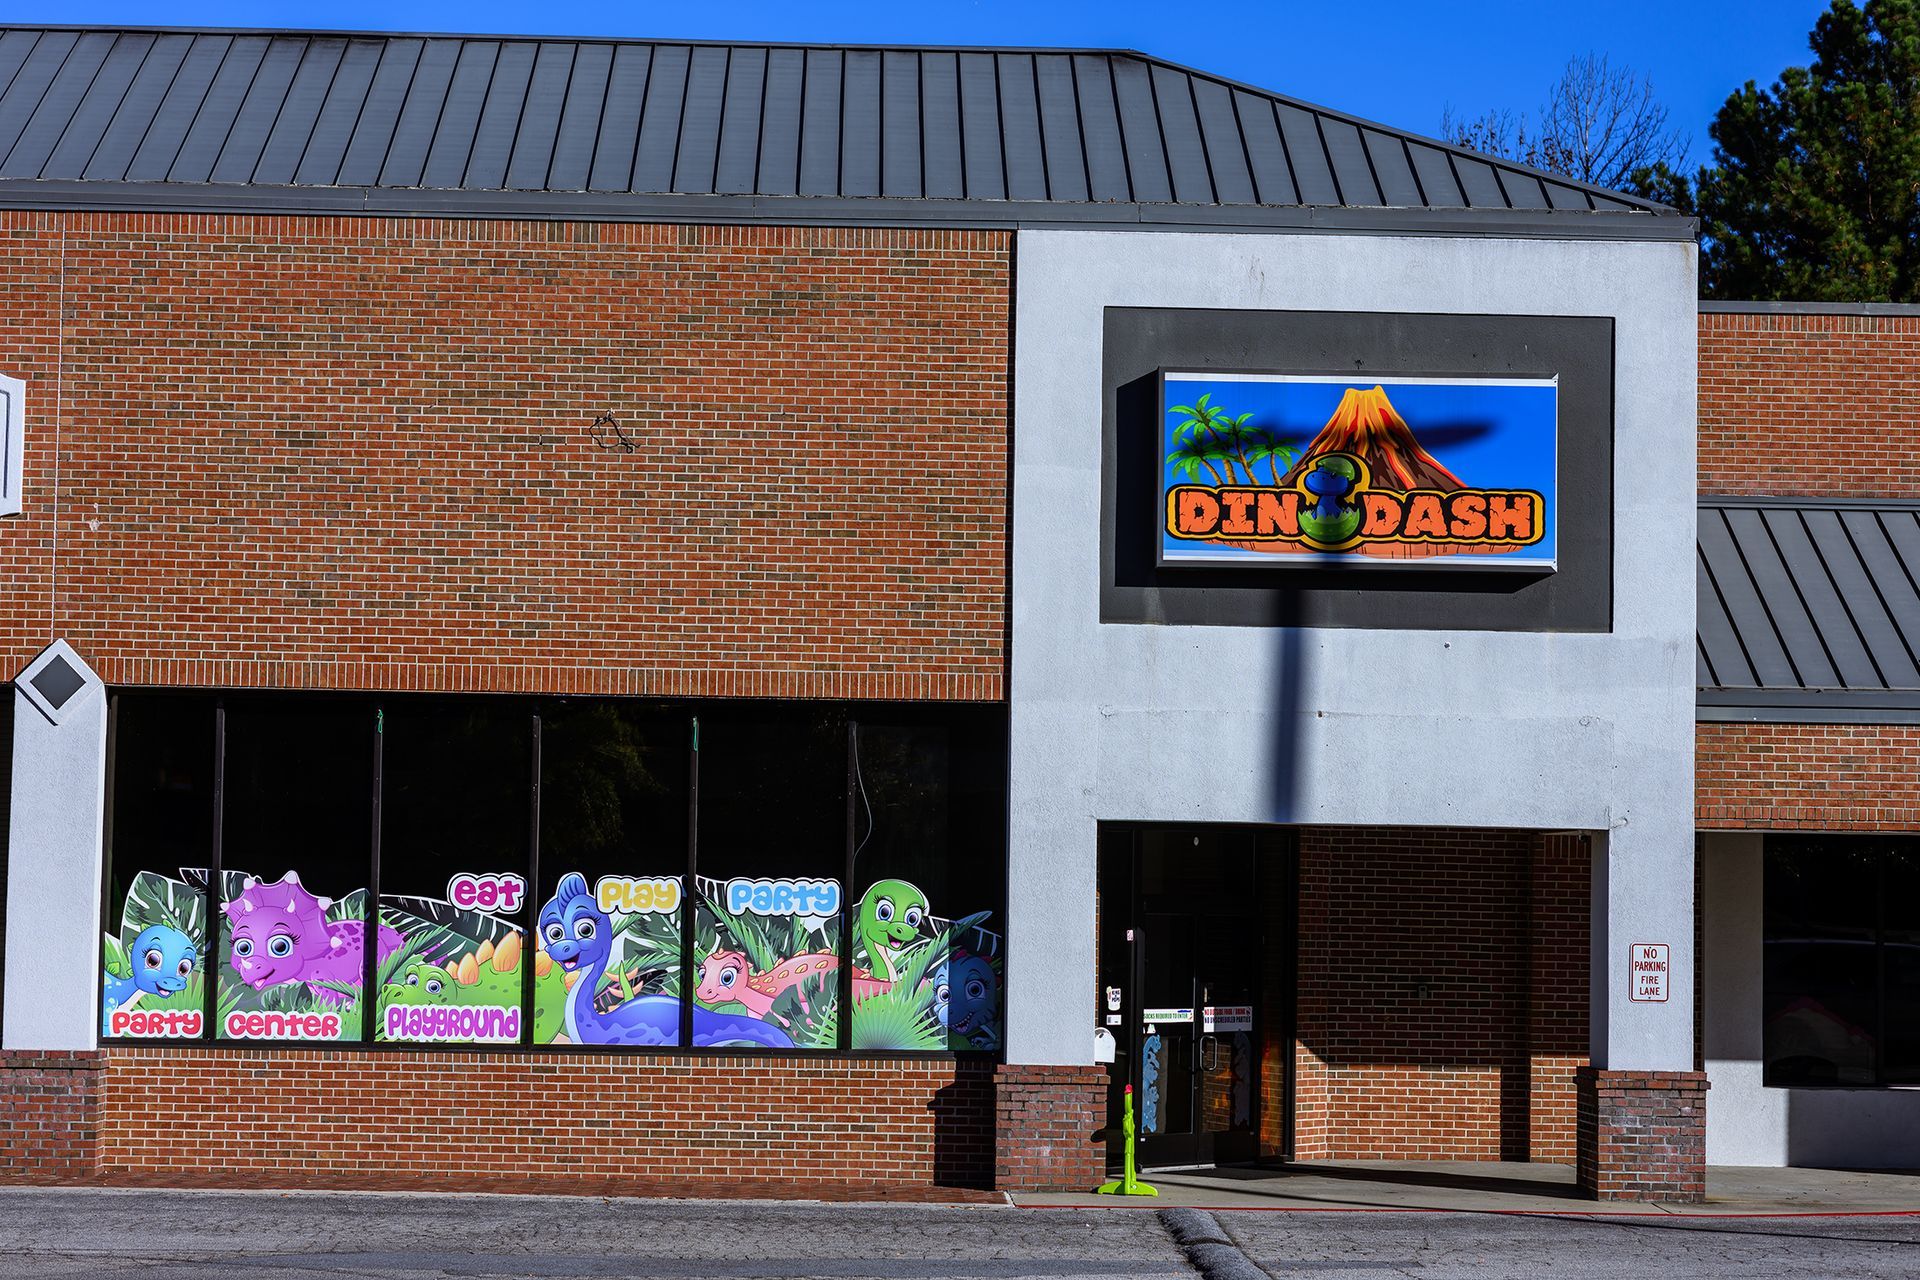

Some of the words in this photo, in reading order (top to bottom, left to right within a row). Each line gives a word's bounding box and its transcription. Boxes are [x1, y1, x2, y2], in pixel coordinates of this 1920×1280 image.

[1361, 493, 1532, 539] DASH
[453, 879, 521, 908] eat
[1643, 948, 1657, 959] NO
[1634, 961, 1666, 972] PARKING
[1641, 976, 1659, 984] FIRE
[1639, 987, 1660, 995] LANE
